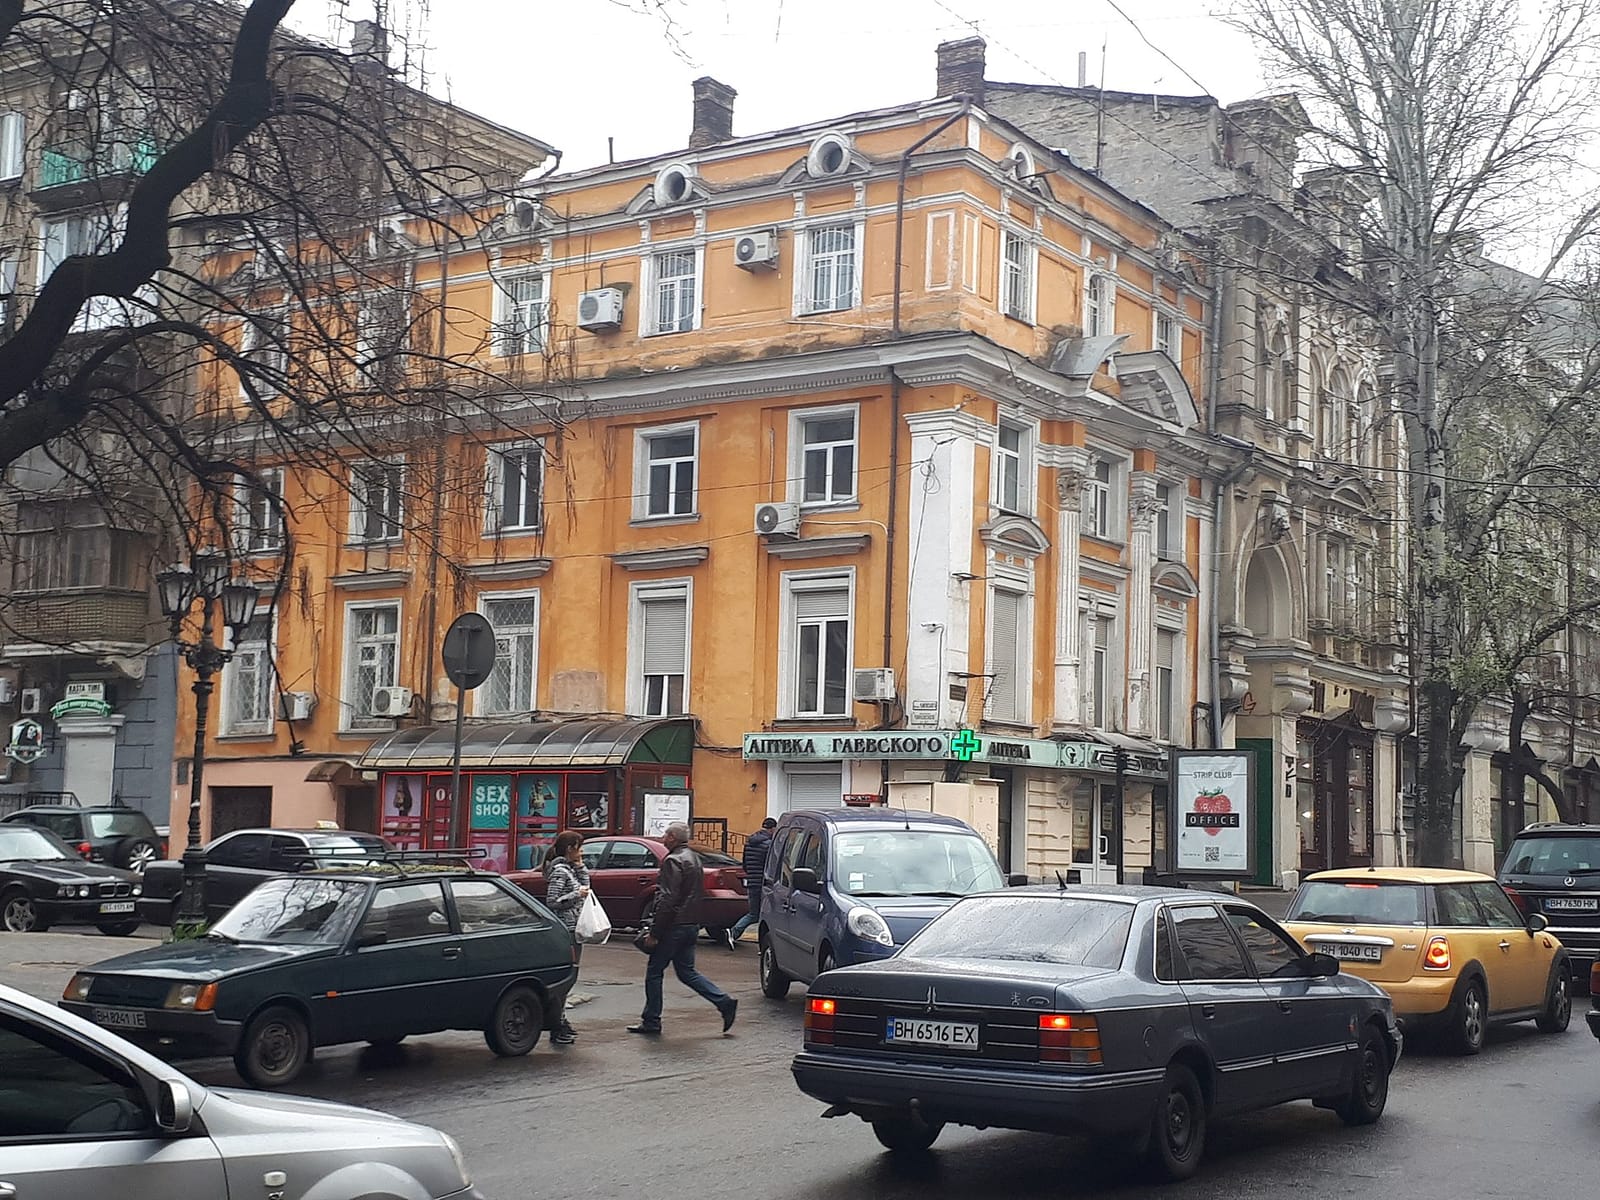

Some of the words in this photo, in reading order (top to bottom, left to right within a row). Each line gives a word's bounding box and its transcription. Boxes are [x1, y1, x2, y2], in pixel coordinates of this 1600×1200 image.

[749, 739, 816, 754] АПТЕКА
[832, 737, 942, 753] ГАЕВСКОГО
[987, 741, 1031, 760] АПТЕКА
[1193, 771, 1212, 779] STRIP
[1214, 771, 1232, 779] CLUB
[475, 785, 509, 803] SEX
[475, 804, 509, 816] SHOP
[1190, 816, 1236, 825] OFFICE
[917, 1023, 949, 1042] 6516
